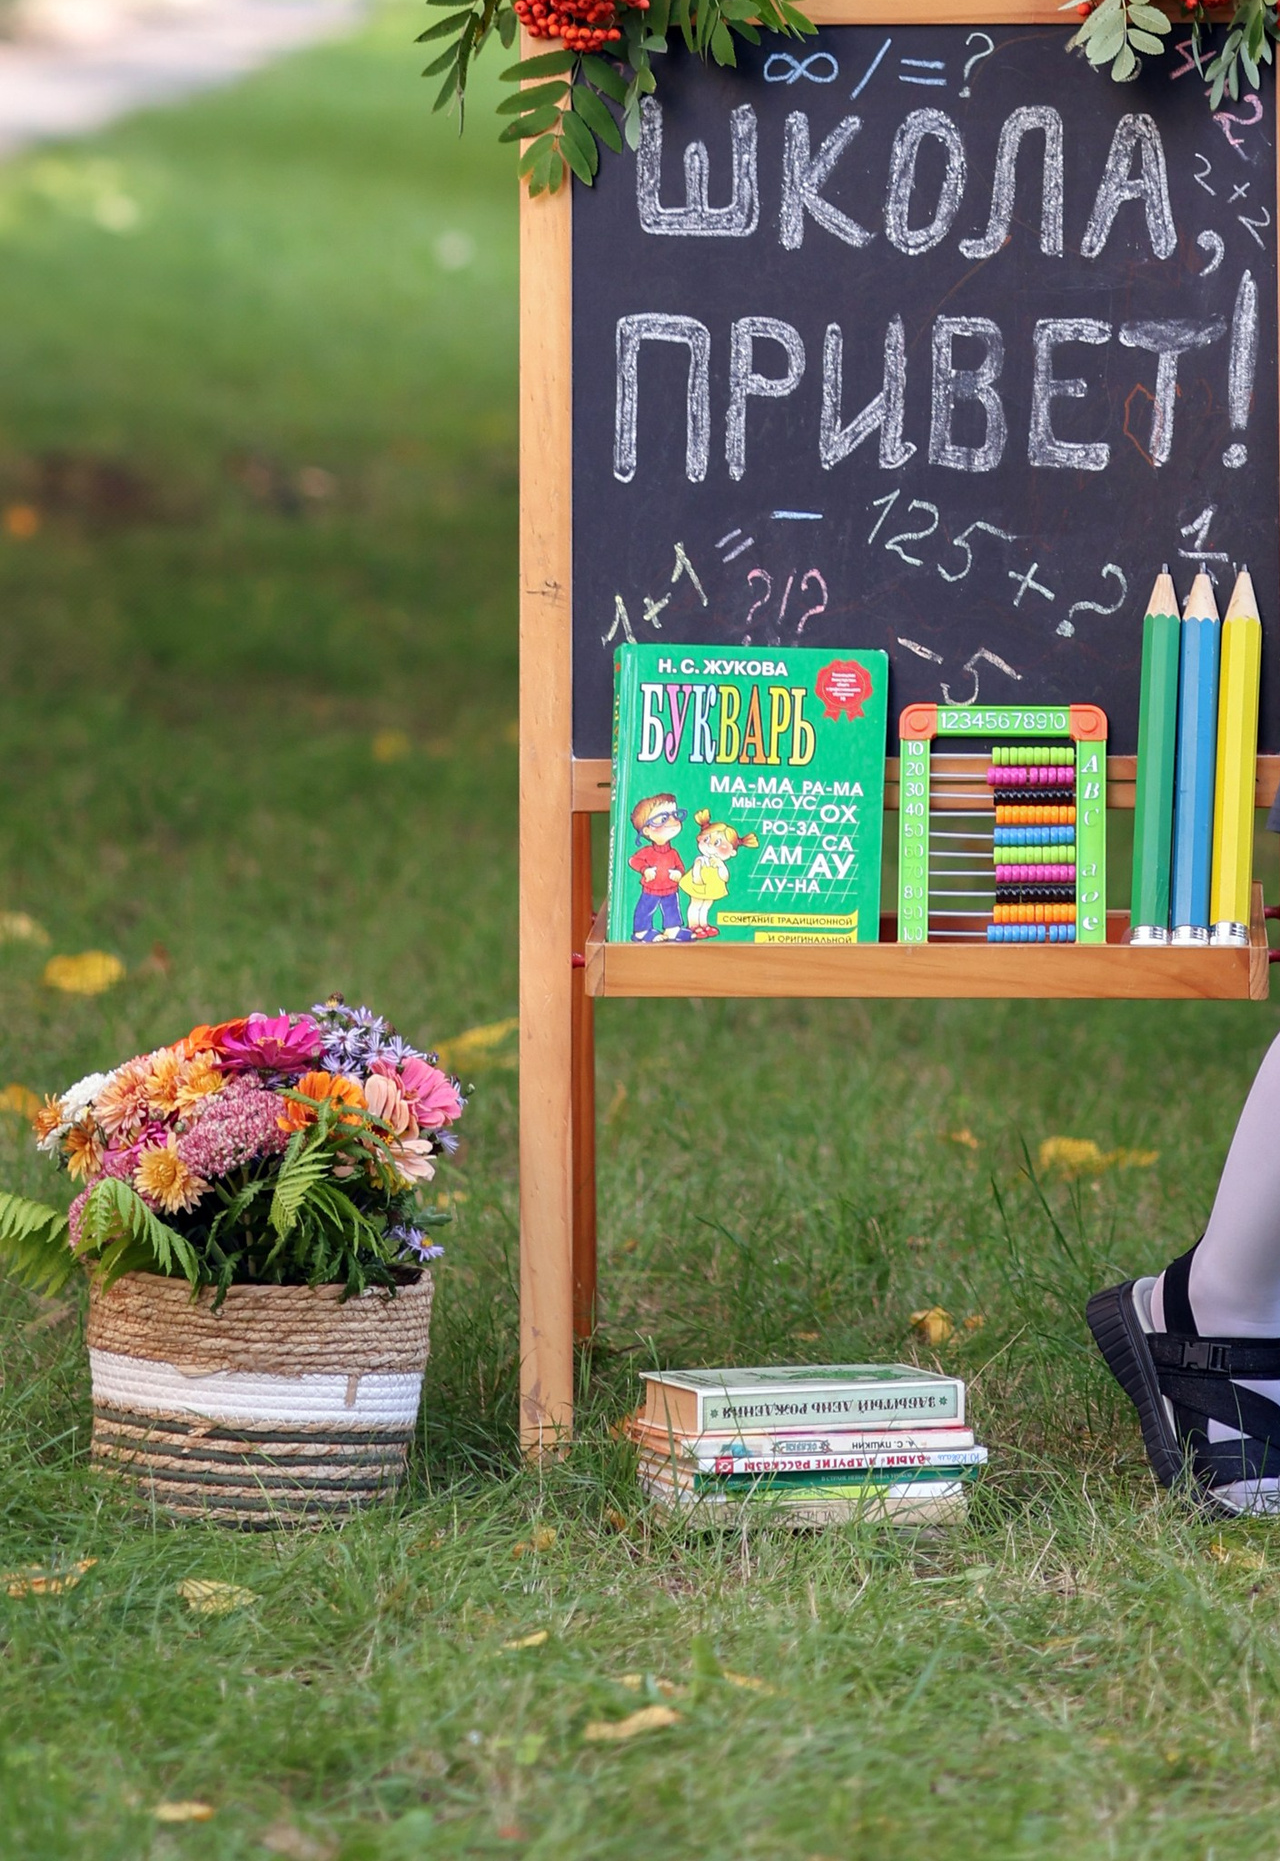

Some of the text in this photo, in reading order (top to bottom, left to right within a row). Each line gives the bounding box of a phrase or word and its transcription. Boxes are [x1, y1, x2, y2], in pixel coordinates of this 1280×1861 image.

[637, 95, 1226, 277] ШКОЛА,
[613, 270, 1260, 483] ПРИВЕТ!
[658, 658, 789, 677] Н. С. ЖУКОВА
[637, 682, 817, 767] БУКВАРЬ
[907, 741, 924, 756] 10
[905, 761, 925, 777] 20
[1081, 754, 1099, 773] A
[710, 775, 864, 797] МА-МА РА-МА
[904, 782, 925, 797] 30
[1082, 781, 1100, 800] B
[731, 795, 817, 811] МЫ-ЛО УС
[904, 802, 924, 817] 40
[819, 804, 858, 824] ОХ
[1083, 808, 1100, 827] C
[761, 820, 821, 836] РО-ЗА
[904, 822, 924, 837] 50
[821, 835, 853, 852] СА
[903, 843, 924, 858] 60
[760, 845, 803, 865] АМ
[806, 853, 856, 880] АУ
[760, 877, 821, 893] ЛУ-НА
[903, 885, 923, 900] 80
[903, 905, 923, 920] 90
[722, 915, 853, 927] СОЧЕТАНИЕ ТРАДИЦИОННОЙ
[903, 925, 923, 941] 100
[721, 1395, 936, 1419] ЗАБЫТЫЙ ДЕНЬ РОЖДЕНИЯ
[851, 1440, 892, 1451] ПУШКИН
[814, 1457, 864, 1470] ДРУГИЕ
